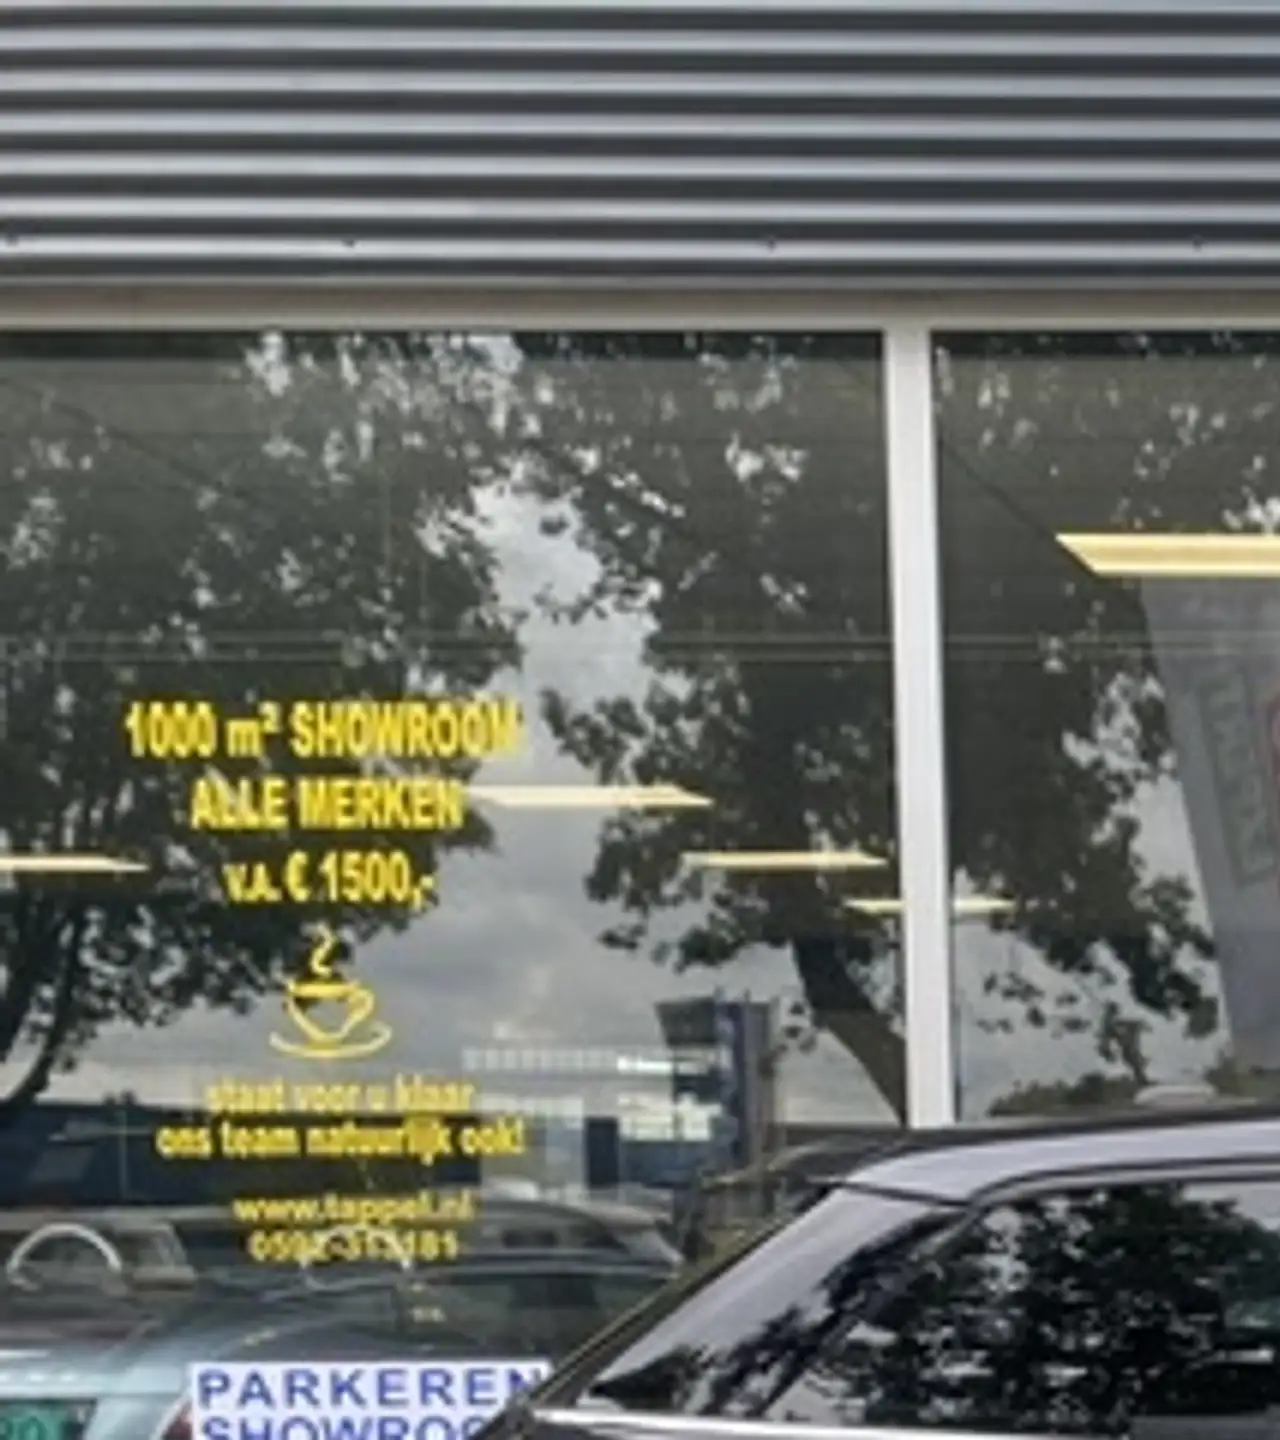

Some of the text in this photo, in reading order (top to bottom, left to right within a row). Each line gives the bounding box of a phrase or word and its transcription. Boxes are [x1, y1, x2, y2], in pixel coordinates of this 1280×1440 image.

[126, 700, 218, 757] 1000
[290, 699, 526, 758] SHOWROOM
[191, 778, 465, 830] ALLE MERKEN
[395, 1074, 475, 1112] klaar
[156, 1126, 213, 1158] ons
[220, 1120, 300, 1157] team
[305, 1119, 453, 1166] natuurlijk
